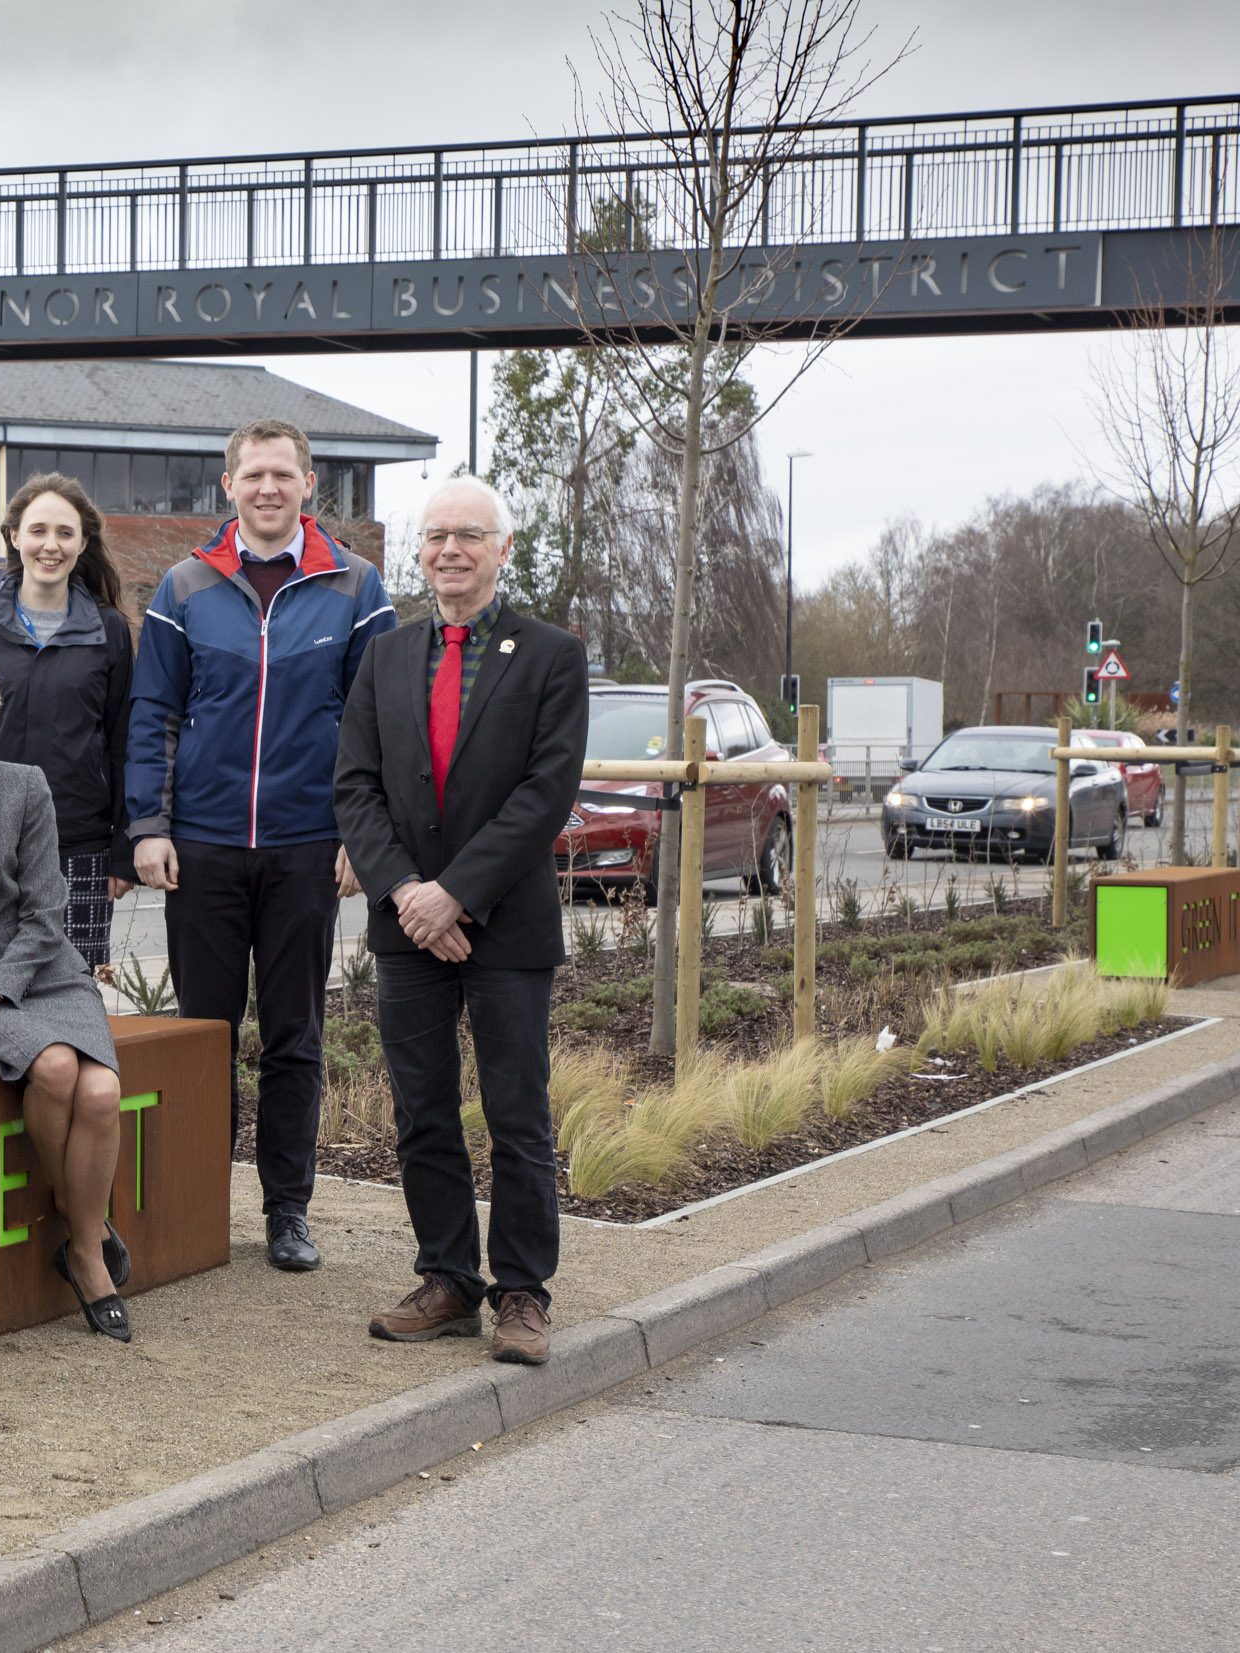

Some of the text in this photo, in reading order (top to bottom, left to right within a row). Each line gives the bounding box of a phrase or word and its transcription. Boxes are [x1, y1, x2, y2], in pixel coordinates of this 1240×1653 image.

[156, 280, 353, 323] ROYAL
[392, 265, 694, 318] BUSINESS
[738, 245, 1083, 304] DISTRICT
[1181, 896, 1222, 953] GREEN
[104, 1089, 163, 1220] T
